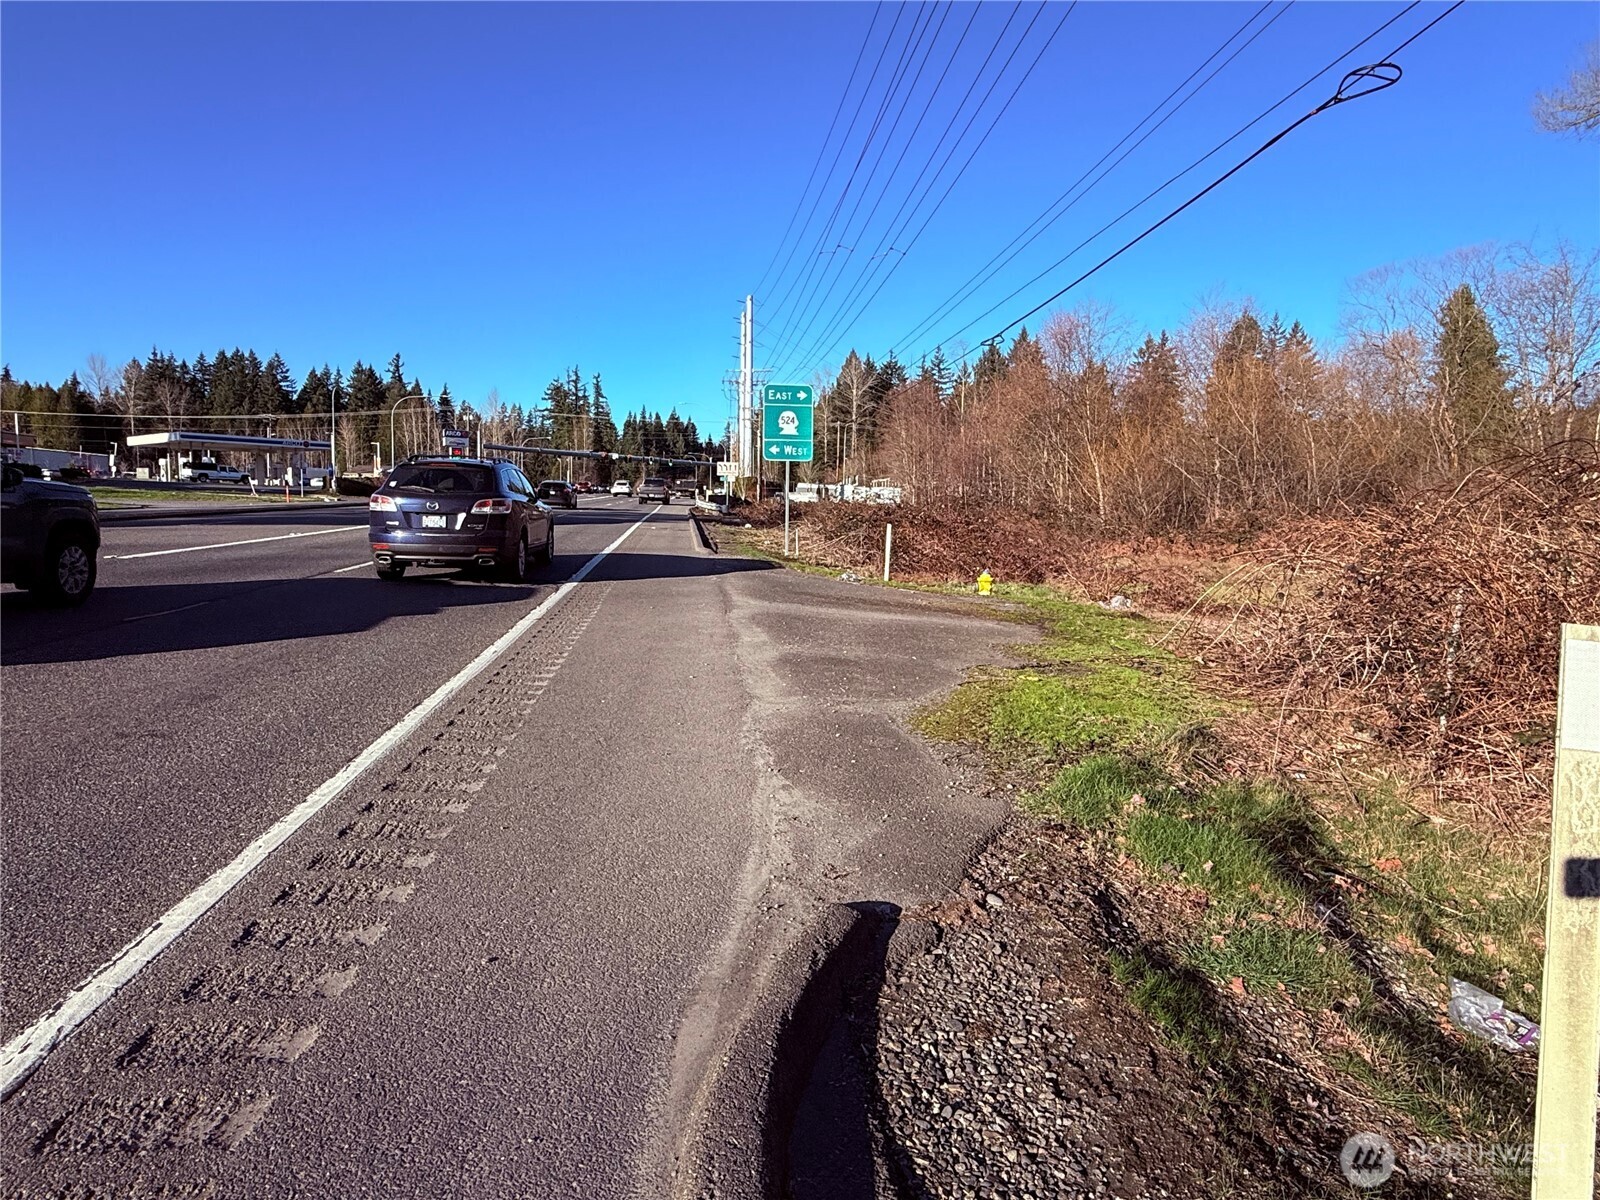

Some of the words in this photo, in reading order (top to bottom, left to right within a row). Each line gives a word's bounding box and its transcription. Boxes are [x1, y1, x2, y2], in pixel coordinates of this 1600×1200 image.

[768, 389, 792, 400] EAST
[781, 415, 795, 425] 524
[783, 444, 808, 456] WEST
